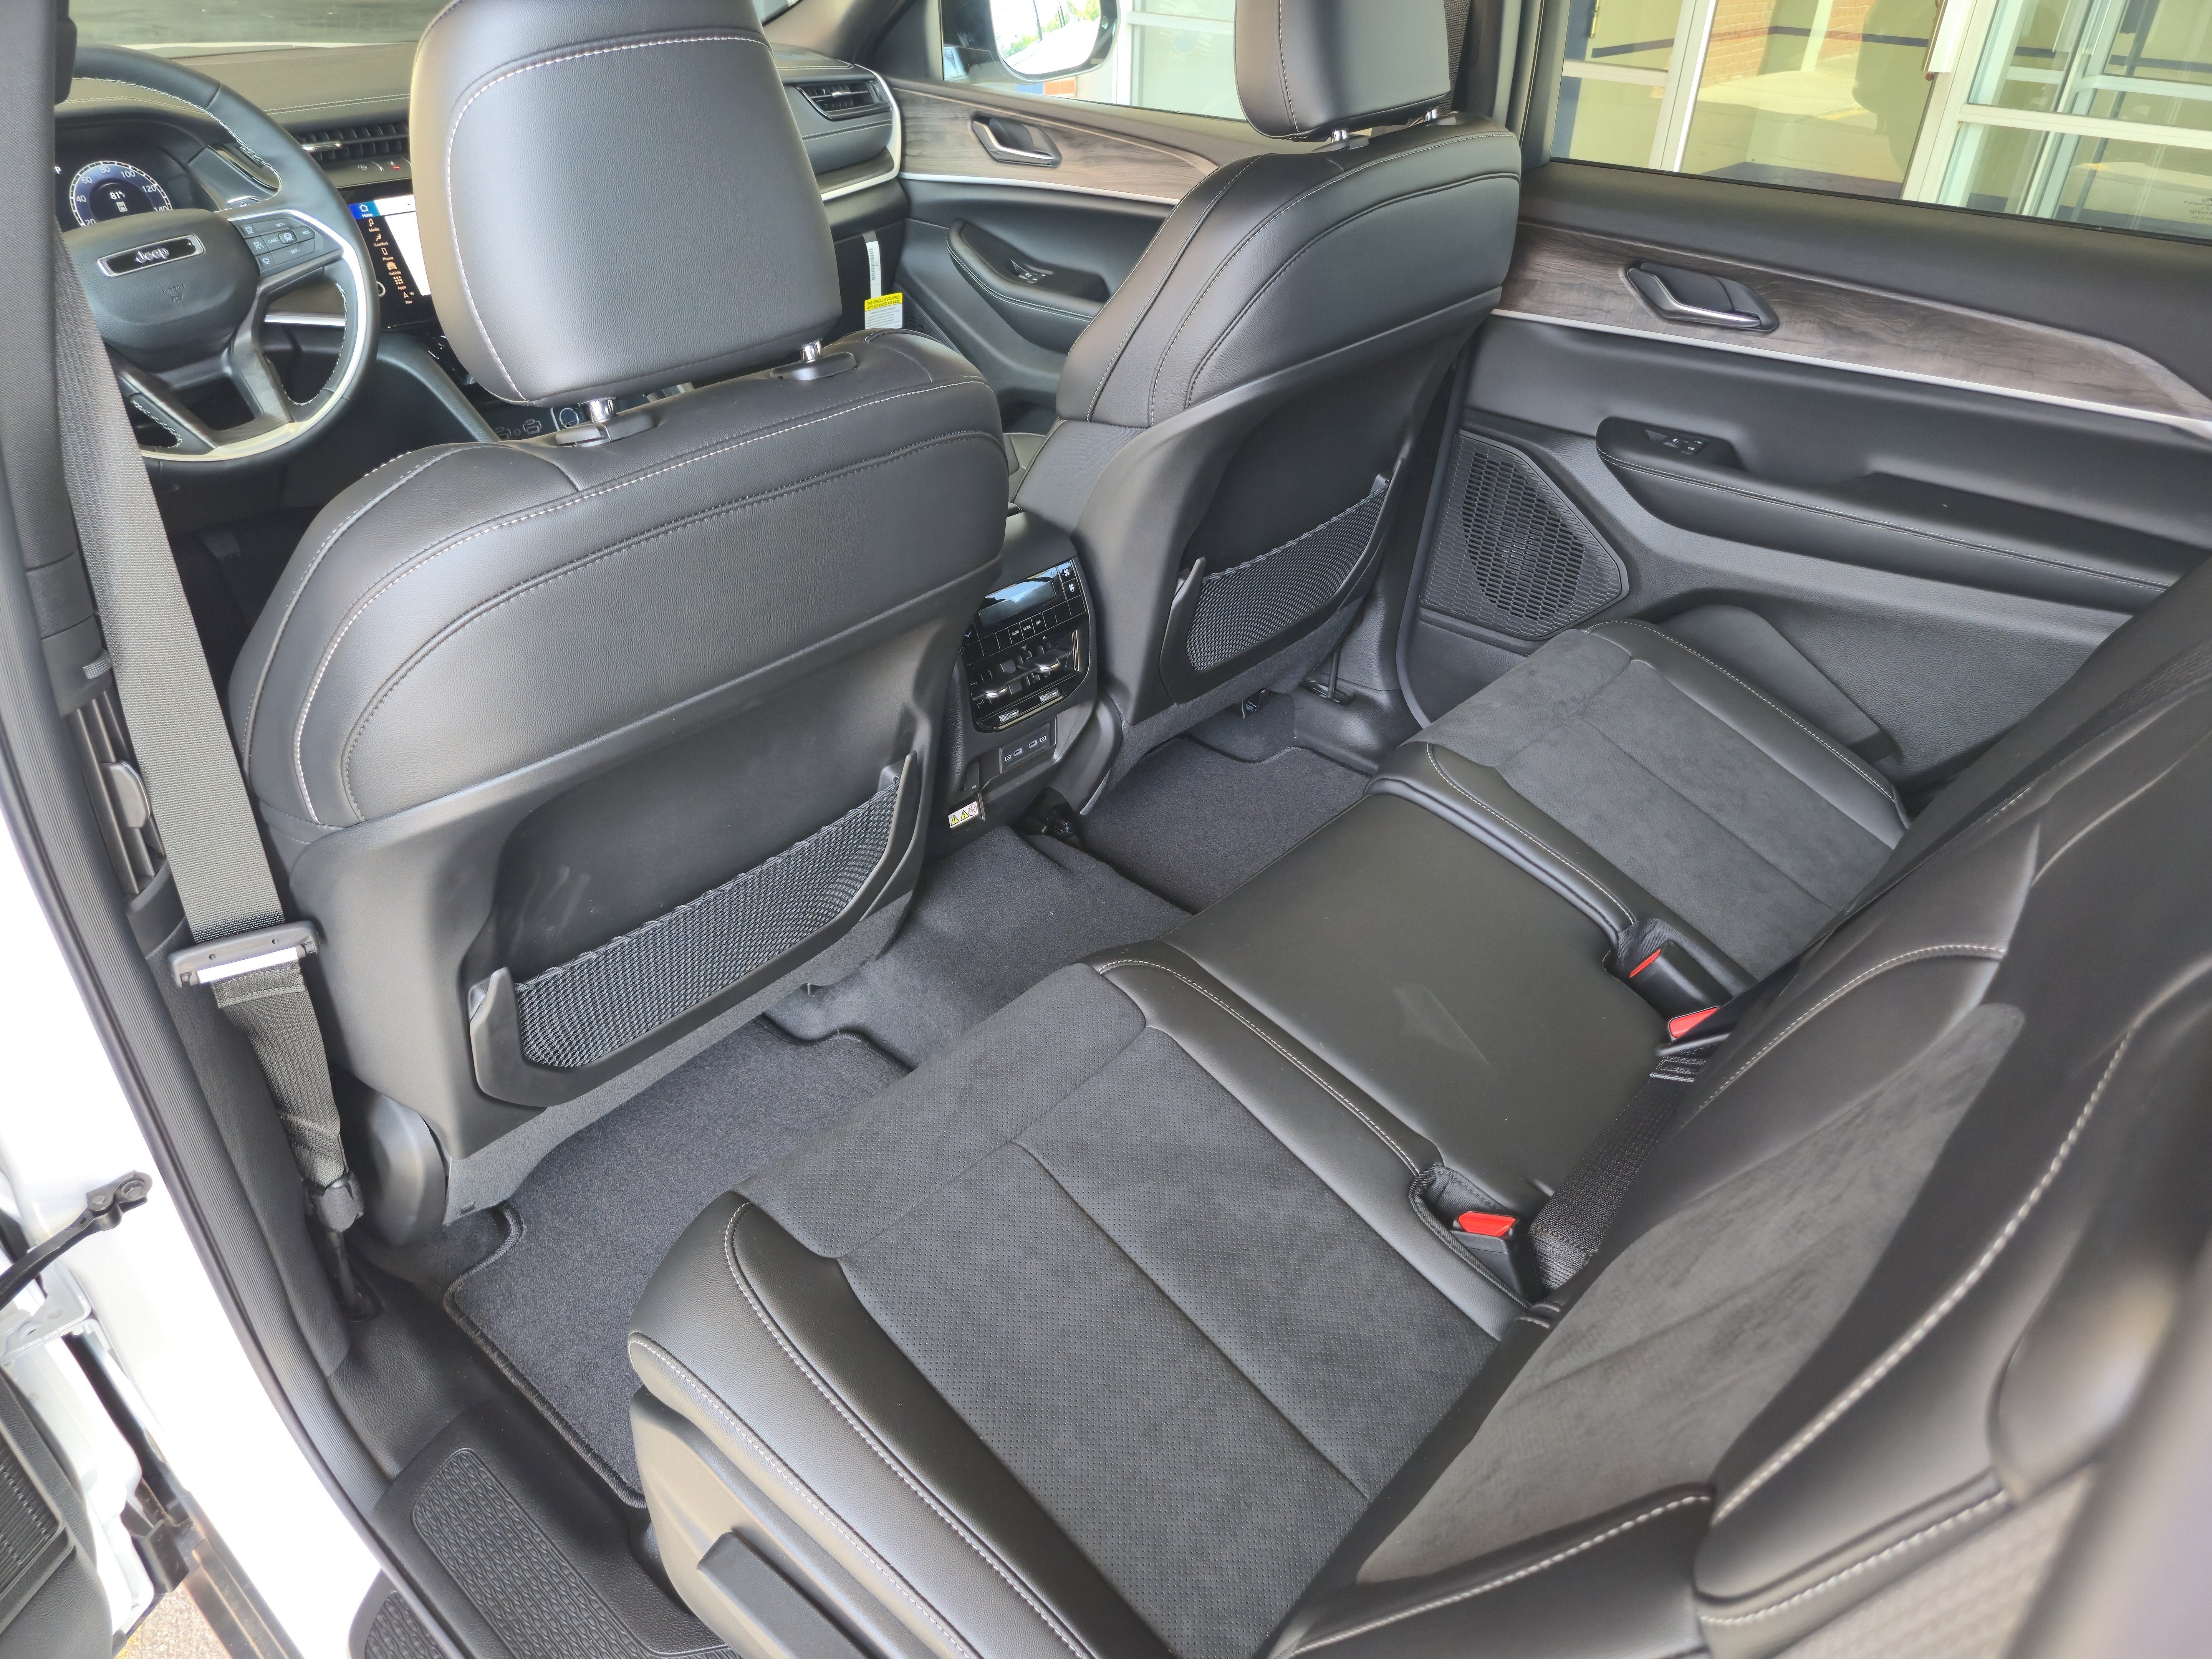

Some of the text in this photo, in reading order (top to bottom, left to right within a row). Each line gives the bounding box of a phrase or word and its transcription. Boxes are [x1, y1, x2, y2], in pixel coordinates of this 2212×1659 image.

[121, 170, 136, 178] 100
[142, 185, 157, 193] 120
[135, 248, 169, 263] Jeep
